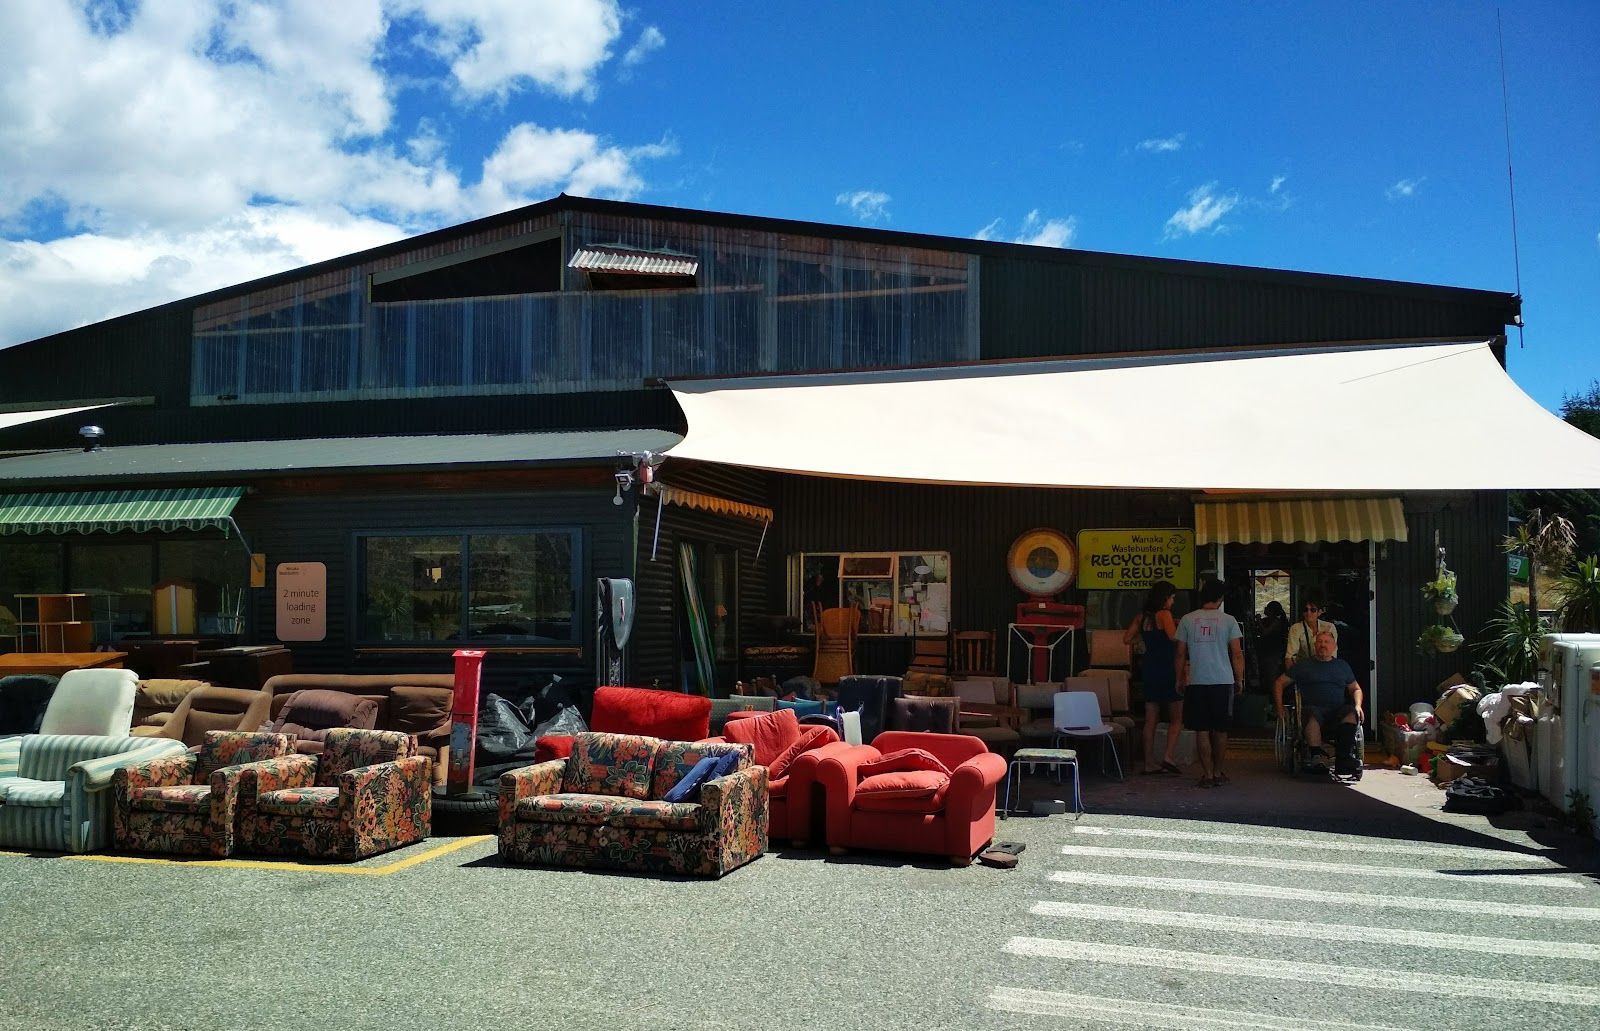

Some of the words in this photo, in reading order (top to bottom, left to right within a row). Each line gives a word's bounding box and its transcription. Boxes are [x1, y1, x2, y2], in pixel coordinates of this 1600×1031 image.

[1132, 535, 1163, 544] Wanaka
[1112, 545, 1163, 553] Wastebusters
[1091, 554, 1181, 567] RECYCLING
[1097, 569, 1114, 579] and
[1121, 567, 1175, 579] REUSE
[283, 590, 289, 598] 2
[290, 590, 319, 598] minute
[286, 602, 316, 612] loading
[291, 617, 311, 625] zone
